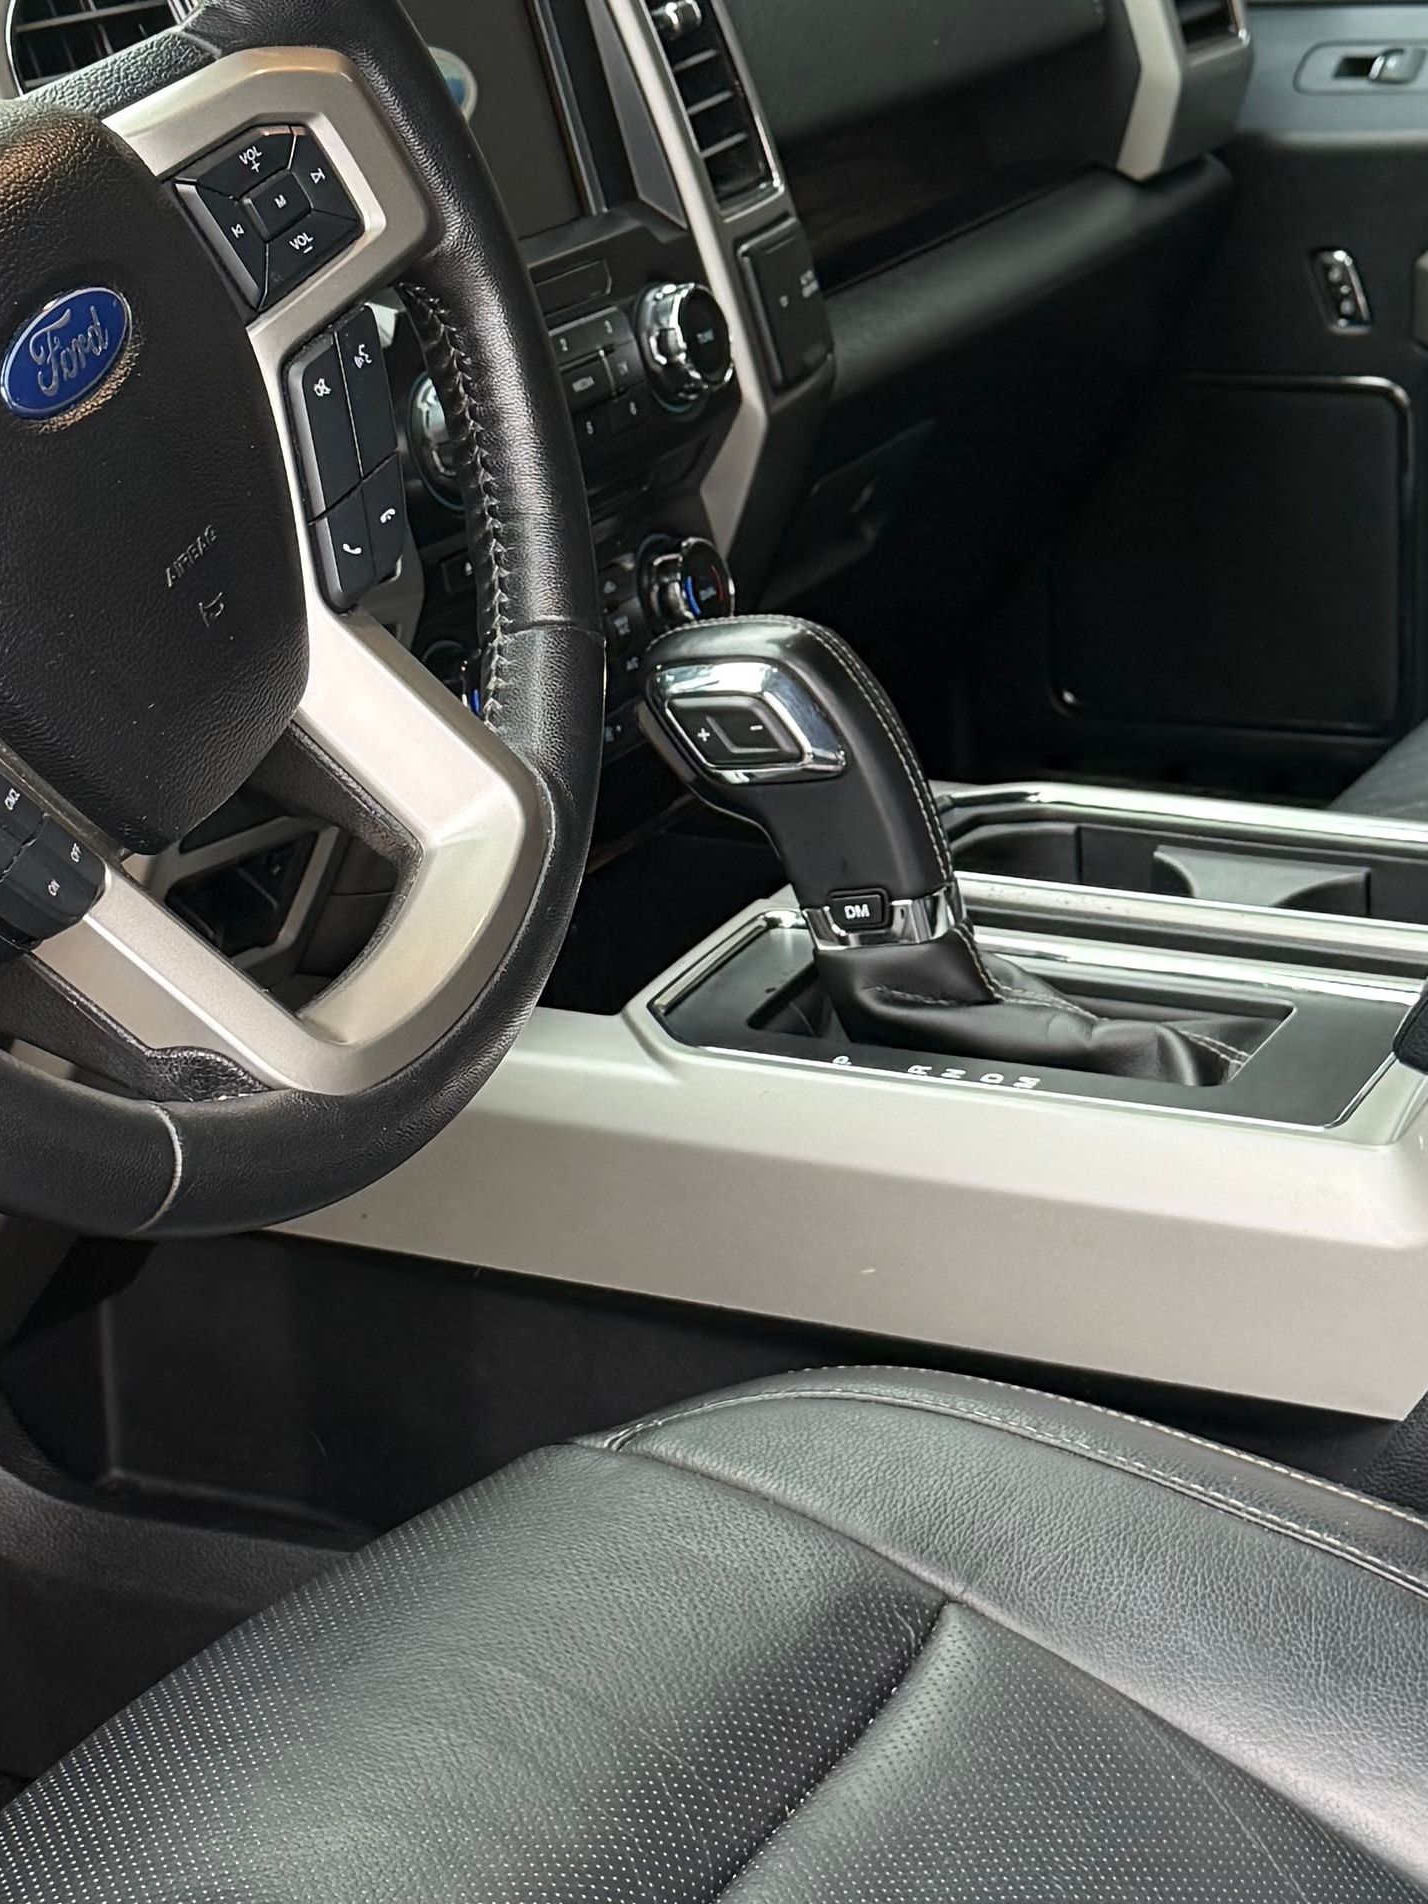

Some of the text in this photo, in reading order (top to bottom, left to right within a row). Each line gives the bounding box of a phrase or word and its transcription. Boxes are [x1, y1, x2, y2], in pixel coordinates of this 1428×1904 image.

[239, 145, 263, 165] VOL
[274, 194, 287, 208] M
[289, 232, 314, 250] VOL
[29, 305, 109, 397] Ford
[844, 903, 870, 919] DM
[907, 1064, 933, 1076] R
[941, 1068, 967, 1079] N
[980, 1073, 1005, 1084] D
[1013, 1075, 1041, 1089] M
